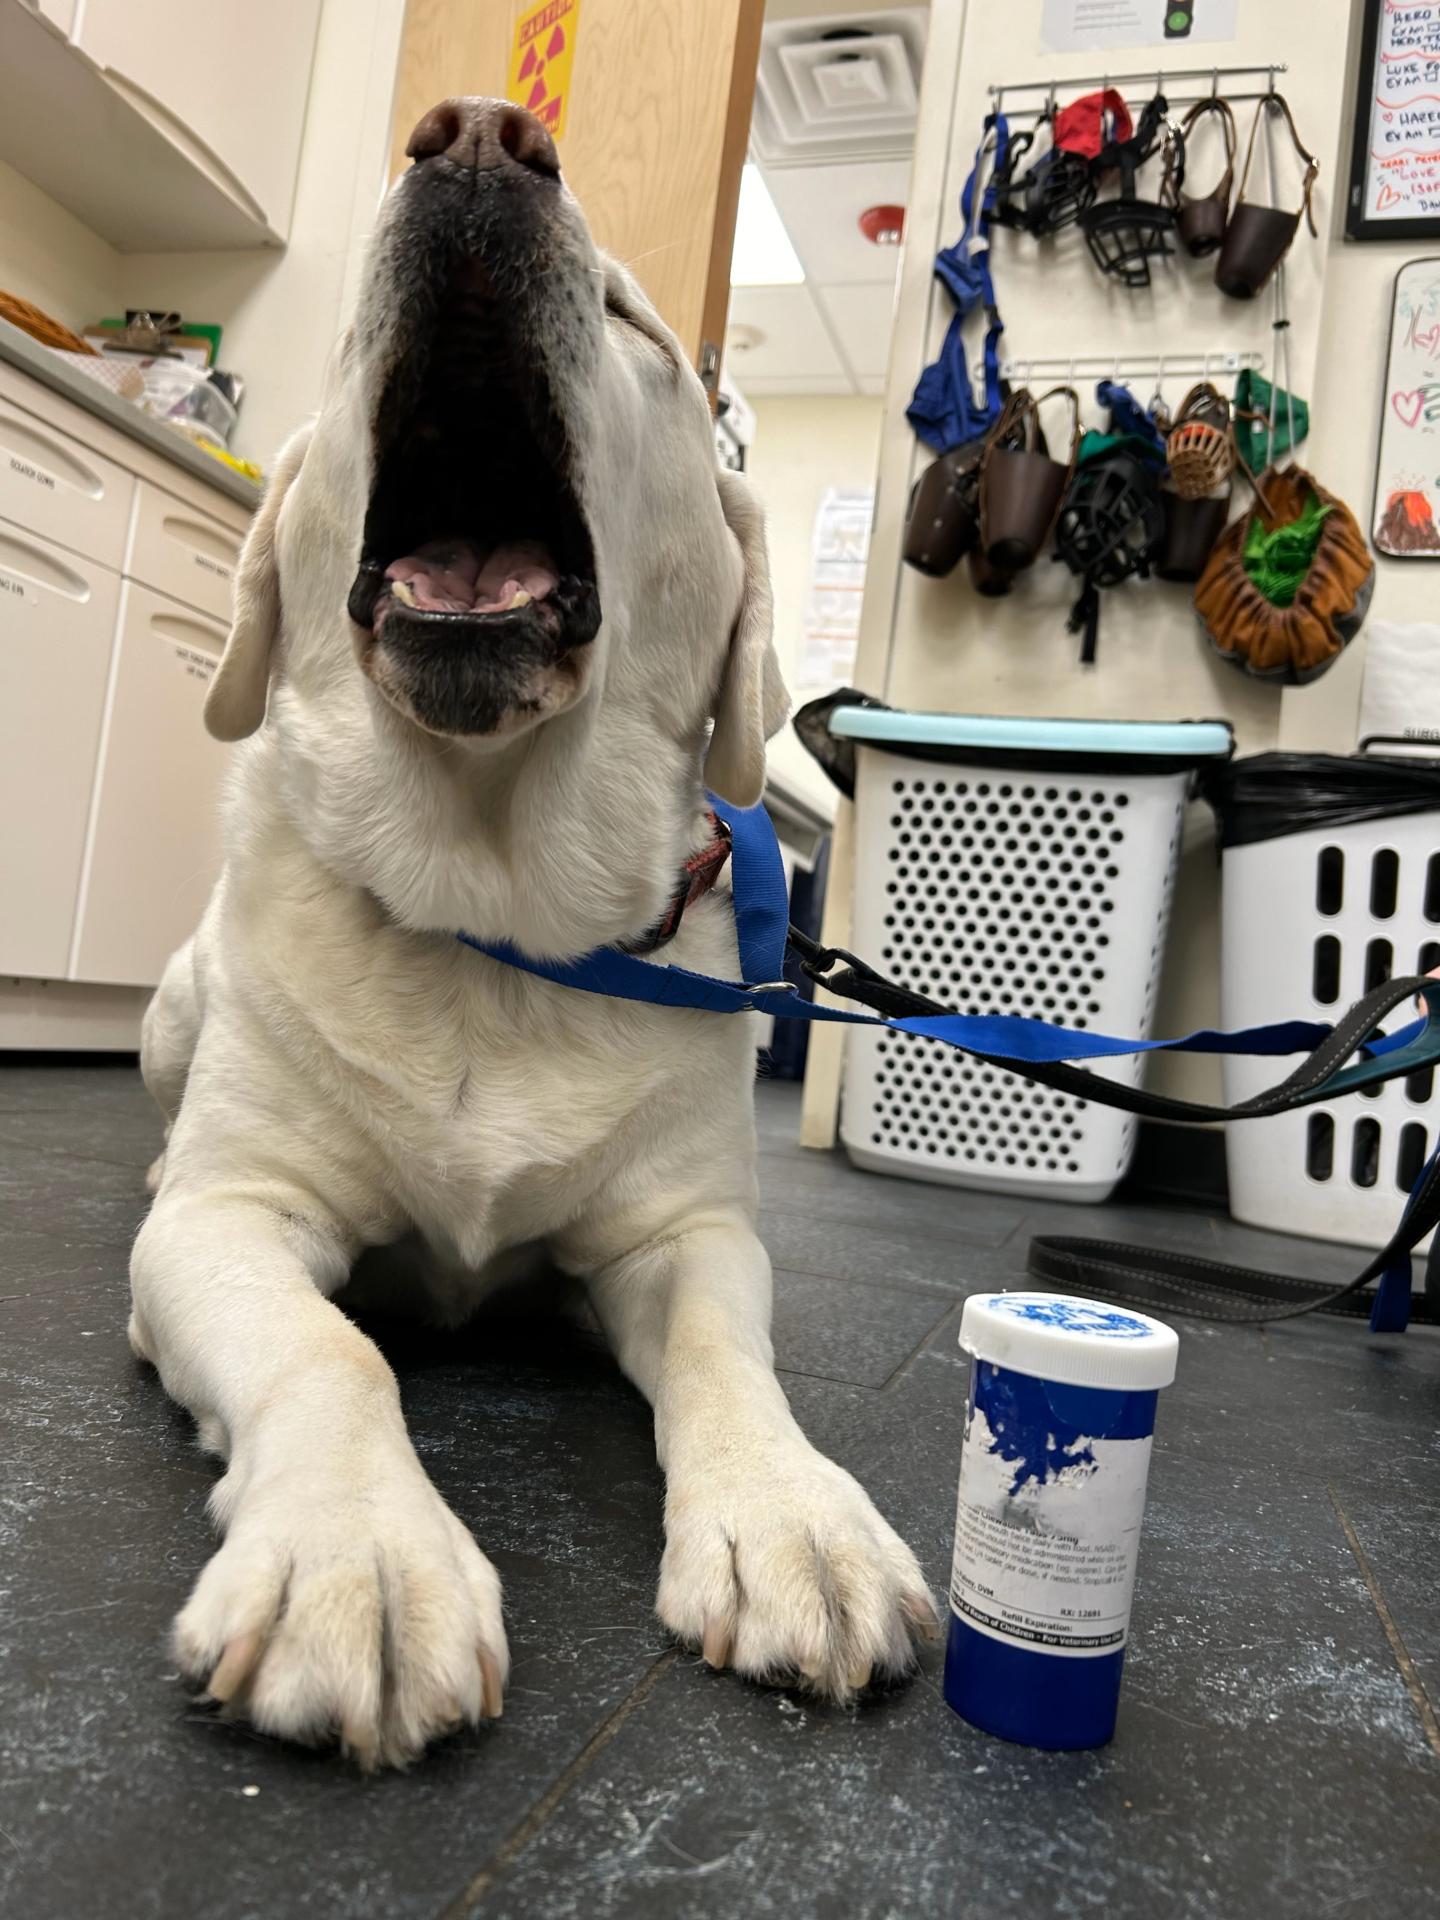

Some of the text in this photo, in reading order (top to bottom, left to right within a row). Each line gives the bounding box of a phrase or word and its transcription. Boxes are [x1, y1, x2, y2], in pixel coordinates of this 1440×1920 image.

[1393, 9, 1432, 24] HERO
[1391, 26, 1424, 37] EXAM
[1386, 76, 1421, 89] EXAM
[1385, 130, 1423, 143] EXAM
[1053, 1541, 1071, 1551] with
[977, 1583, 995, 1598] DVM
[1060, 1607, 1076, 1617] RX:
[969, 1606, 990, 1625] Reach
[990, 1618, 1000, 1628] of
[999, 1621, 1036, 1640] Children
[1042, 1634, 1058, 1644] For
[1059, 1636, 1100, 1647] Veterinary
[1001, 1609, 1073, 1633] Refill Expiration:
